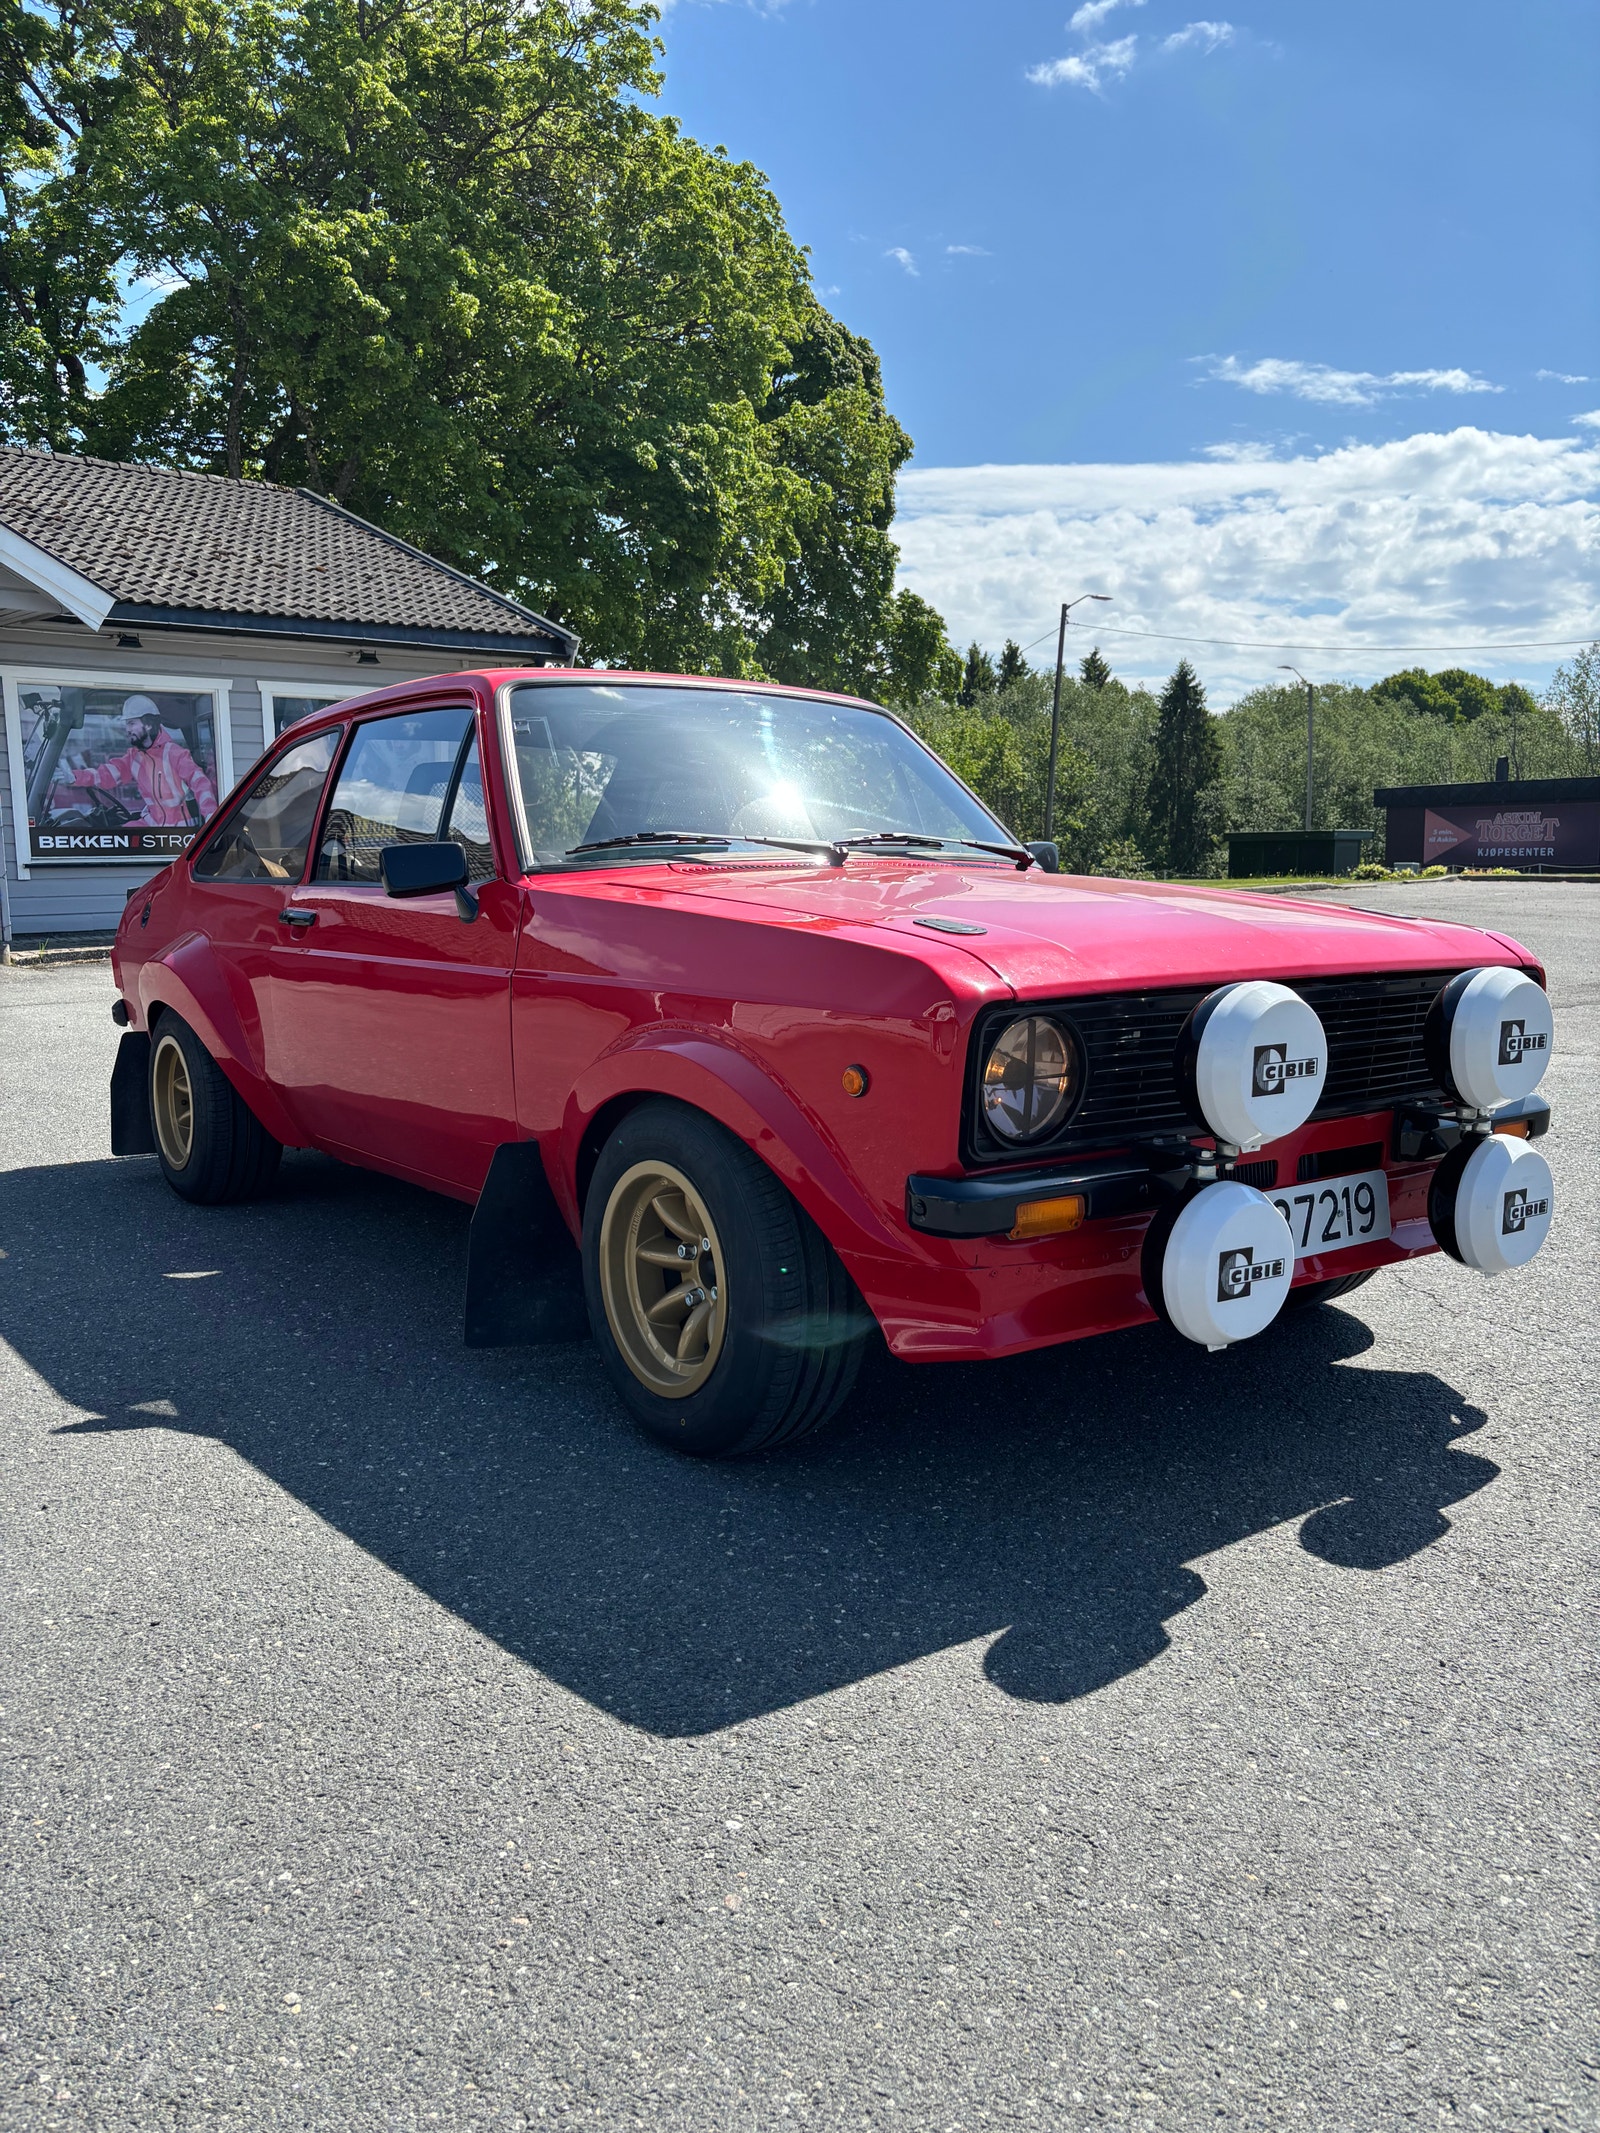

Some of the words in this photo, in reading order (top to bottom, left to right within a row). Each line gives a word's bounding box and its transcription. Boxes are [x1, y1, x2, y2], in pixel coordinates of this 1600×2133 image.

[1493, 812, 1541, 825] ASKIM
[1475, 818, 1560, 842] TORGET
[38, 835, 129, 849] BEKKEN
[1477, 847, 1554, 857] KJØPESENTER
